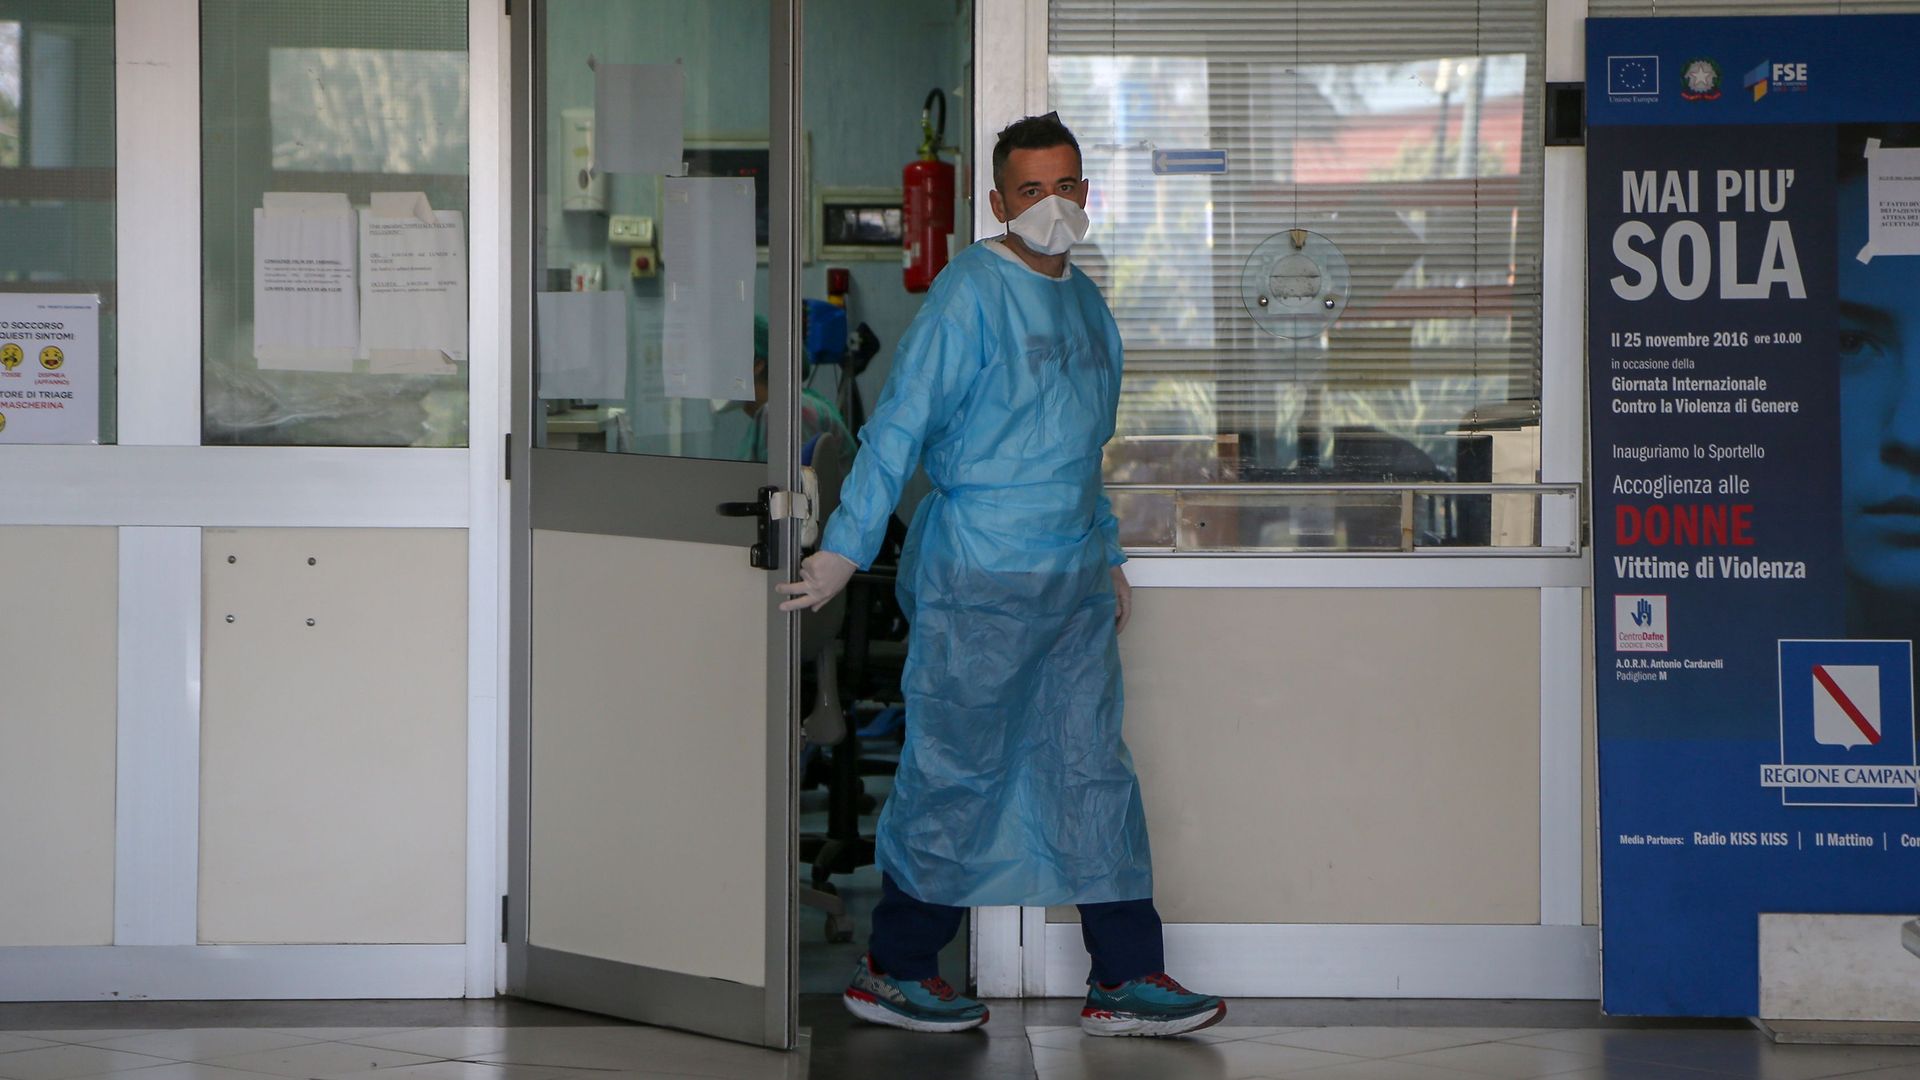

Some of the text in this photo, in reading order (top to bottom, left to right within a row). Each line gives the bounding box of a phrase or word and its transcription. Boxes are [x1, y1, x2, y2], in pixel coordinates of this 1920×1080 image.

[1773, 64, 1807, 81] FSE
[1623, 170, 1794, 213] MAI PIU'
[1610, 220, 1807, 301] SOLA
[10, 321, 64, 330] SOCCORSO
[0, 332, 33, 340] QUESTI
[1612, 332, 1801, 347] Il 25 novembre 2016 ore 10.00
[1612, 358, 1694, 369] in occasione della
[1612, 377, 1766, 391] Giornata Internazionale
[40, 391, 73, 399] TRIAGE
[0, 401, 64, 409] MASCHERINA
[1612, 399, 1798, 413] Contro la Violenza di Genere
[1613, 444, 1764, 462] Inauguriamo lo Sportello
[1613, 475, 1749, 498] Accoglienza alle
[1616, 505, 1754, 545] DONNE
[1614, 556, 1805, 578] Vittime di Violenza
[1616, 659, 1723, 668] A.O.R.N. Antonio Cardarelli
[1617, 671, 1667, 682] Padiglione M
[1764, 768, 1839, 783] REGIONE
[1620, 835, 1644, 844] Media
[1647, 835, 1684, 844] Partners:
[1694, 832, 1726, 845] Radio
[1730, 832, 1757, 845] KISS
[1761, 833, 1787, 845] KISS
[1816, 833, 1823, 846] Il
[1828, 833, 1873, 846] Mattino
